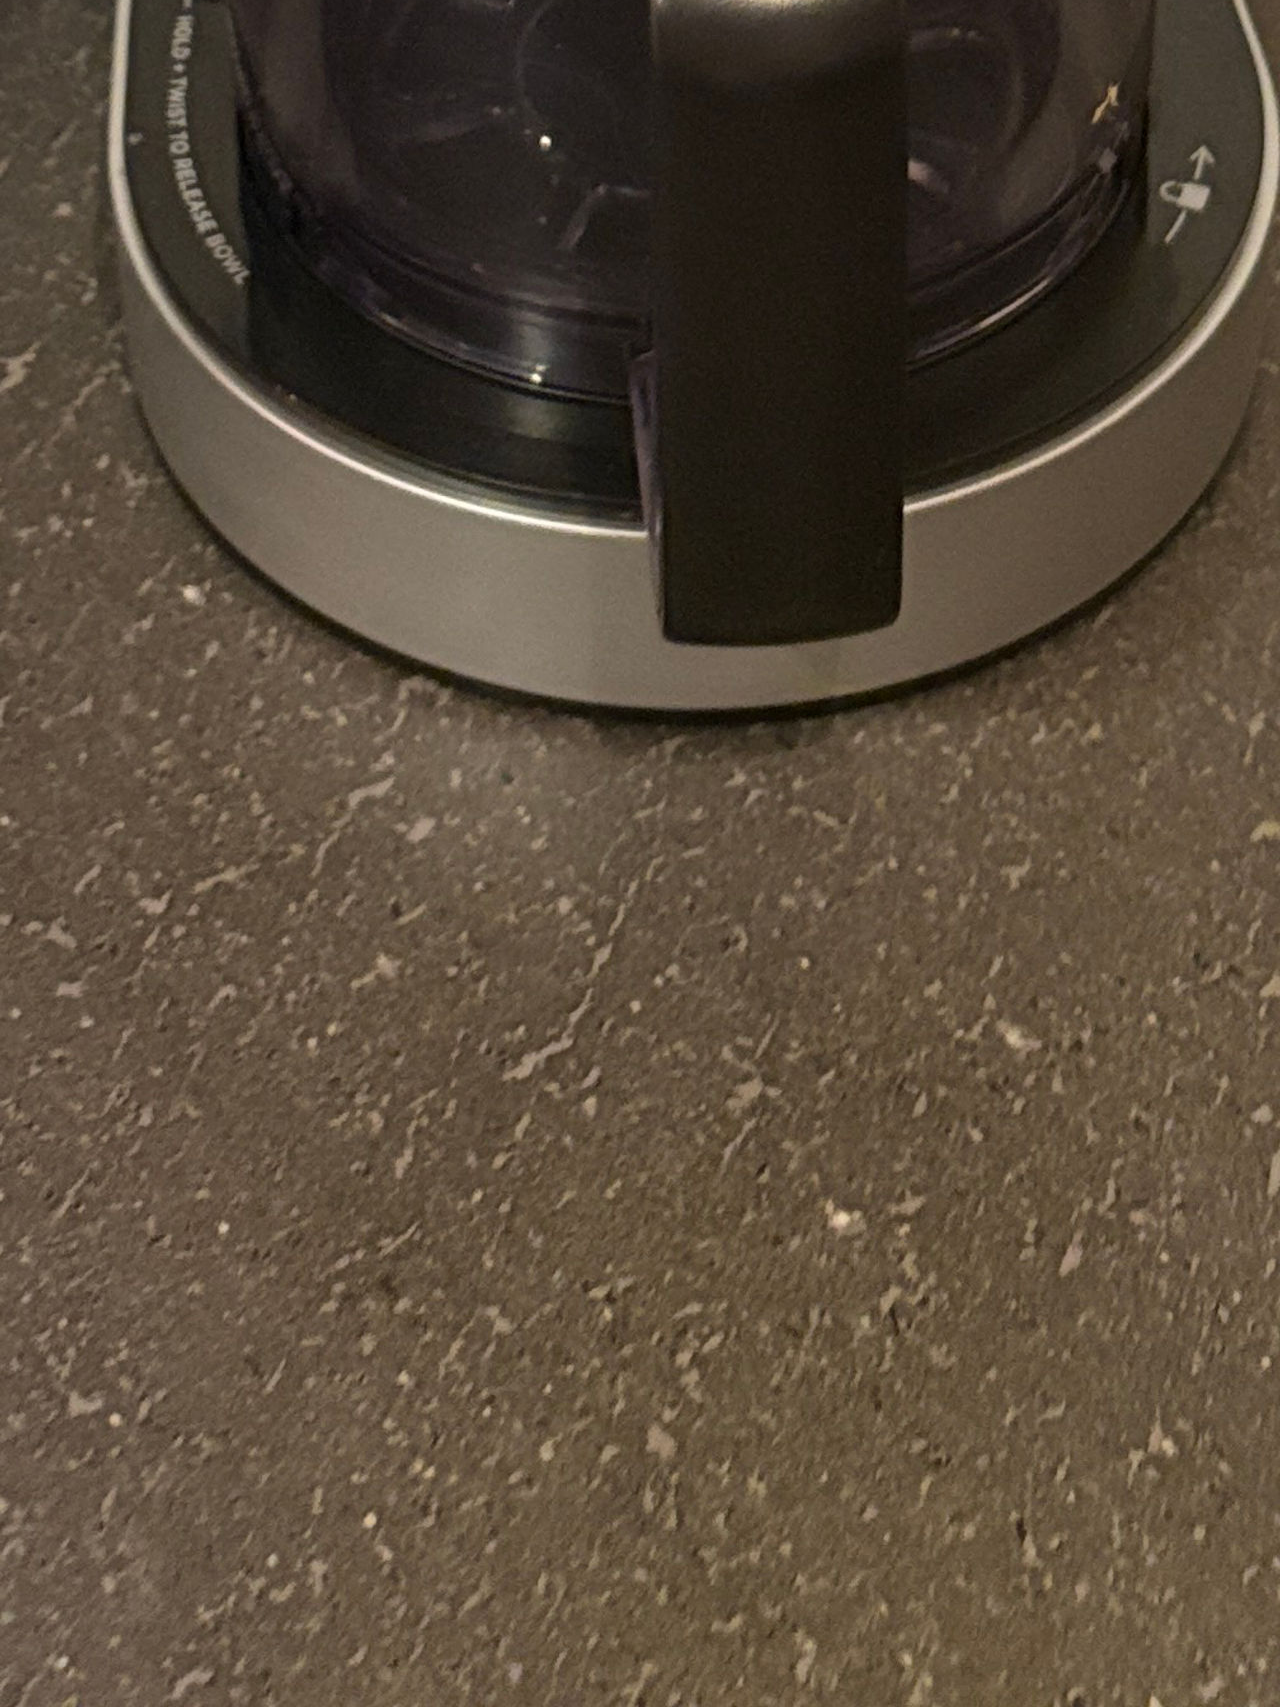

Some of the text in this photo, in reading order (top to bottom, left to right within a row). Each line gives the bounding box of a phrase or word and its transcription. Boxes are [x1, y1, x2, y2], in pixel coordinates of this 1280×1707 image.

[171, 15, 195, 61] HOLD
[166, 75, 189, 127] TWIST
[168, 131, 190, 154] TO
[173, 157, 219, 234] RELEASE
[205, 233, 250, 285] BOWL
